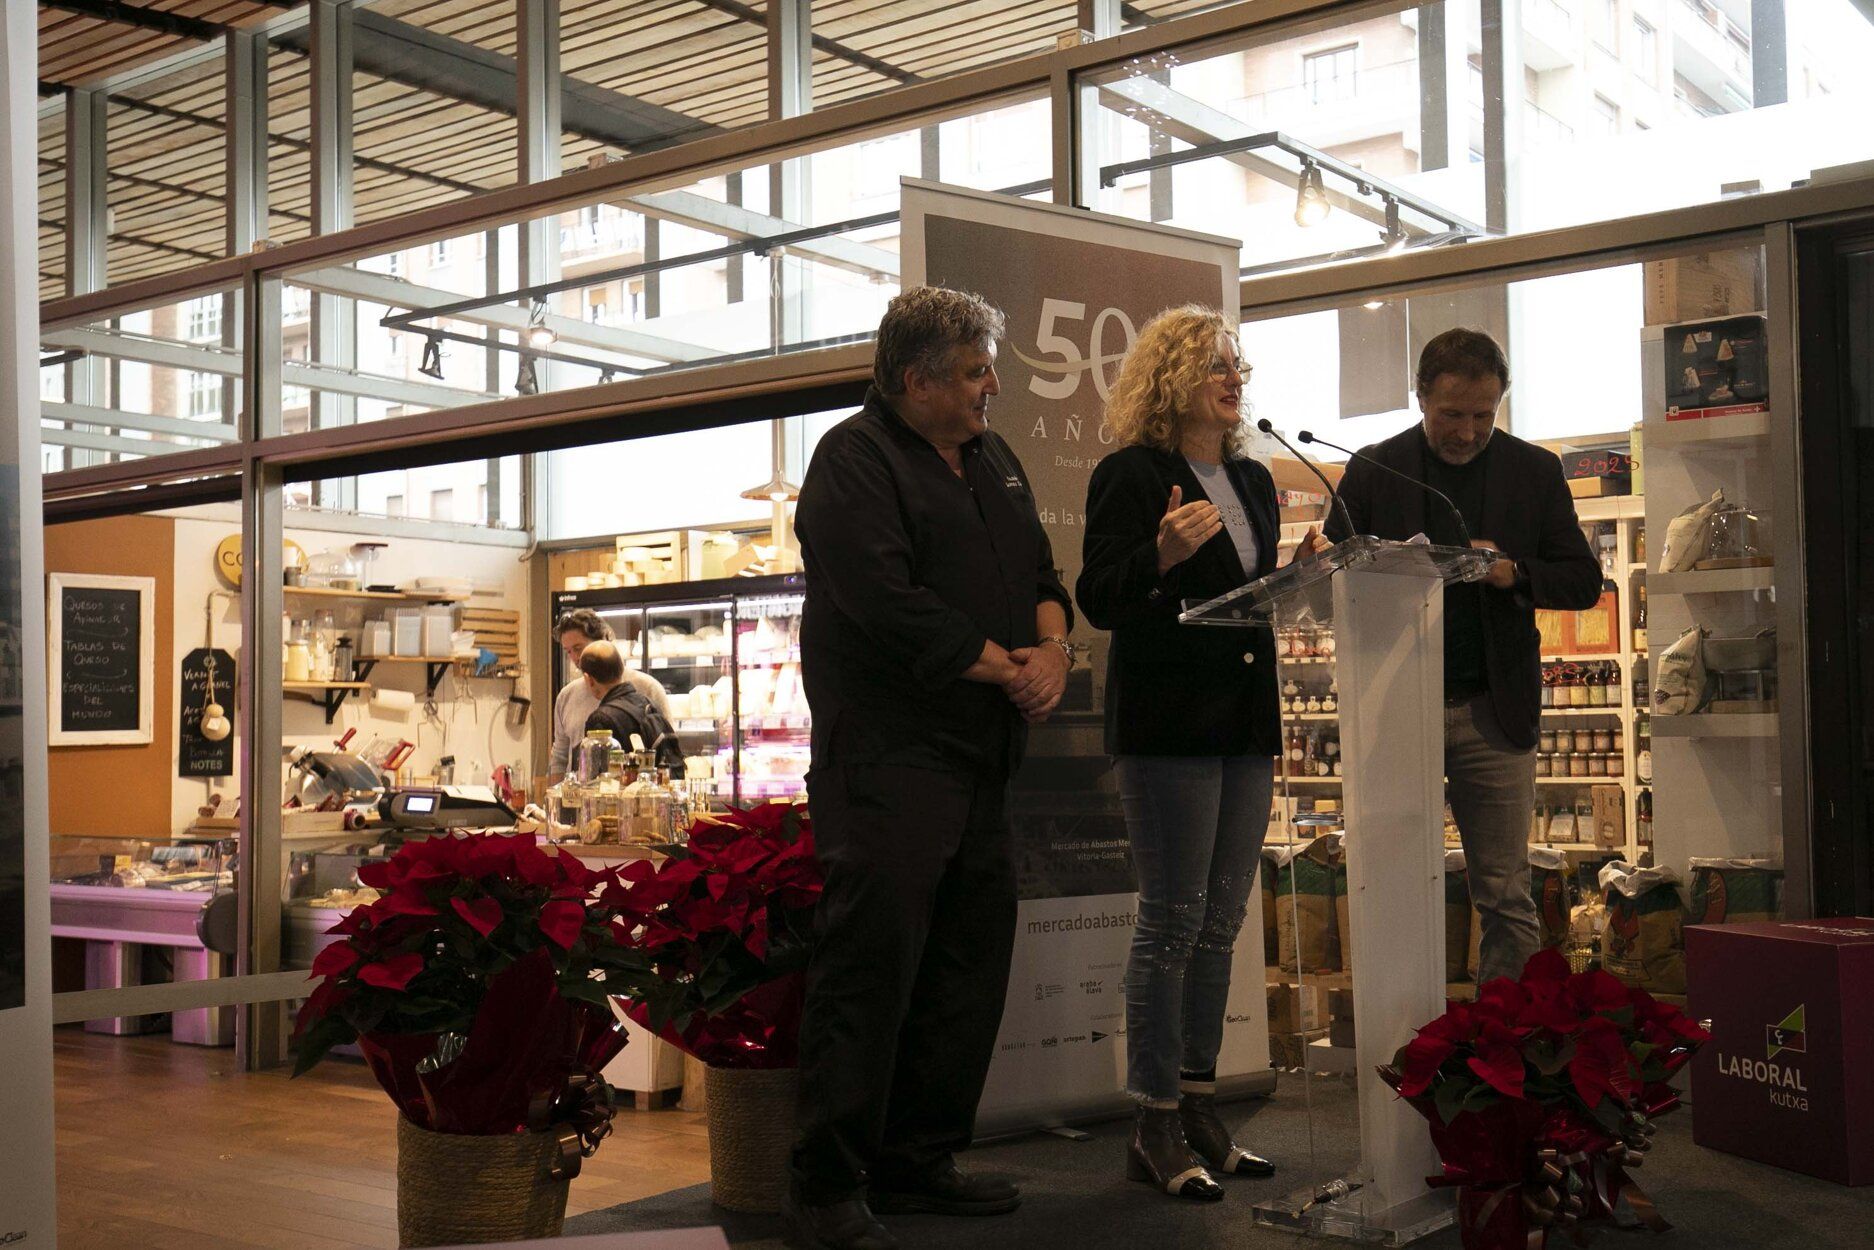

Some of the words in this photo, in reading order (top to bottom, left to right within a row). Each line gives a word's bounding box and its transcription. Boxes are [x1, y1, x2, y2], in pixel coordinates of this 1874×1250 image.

[1028, 297, 1138, 405] 50
[1055, 455, 1085, 469] Desde
[1086, 457, 1103, 470] 19
[1062, 508, 1075, 525] la
[190, 759, 223, 770] NOTES
[1051, 841, 1080, 851] Mercado
[1081, 840, 1090, 850] de
[1091, 839, 1117, 849] Abastos
[1718, 1052, 1808, 1092] LABORAL
[1769, 1088, 1809, 1112] kutxa
